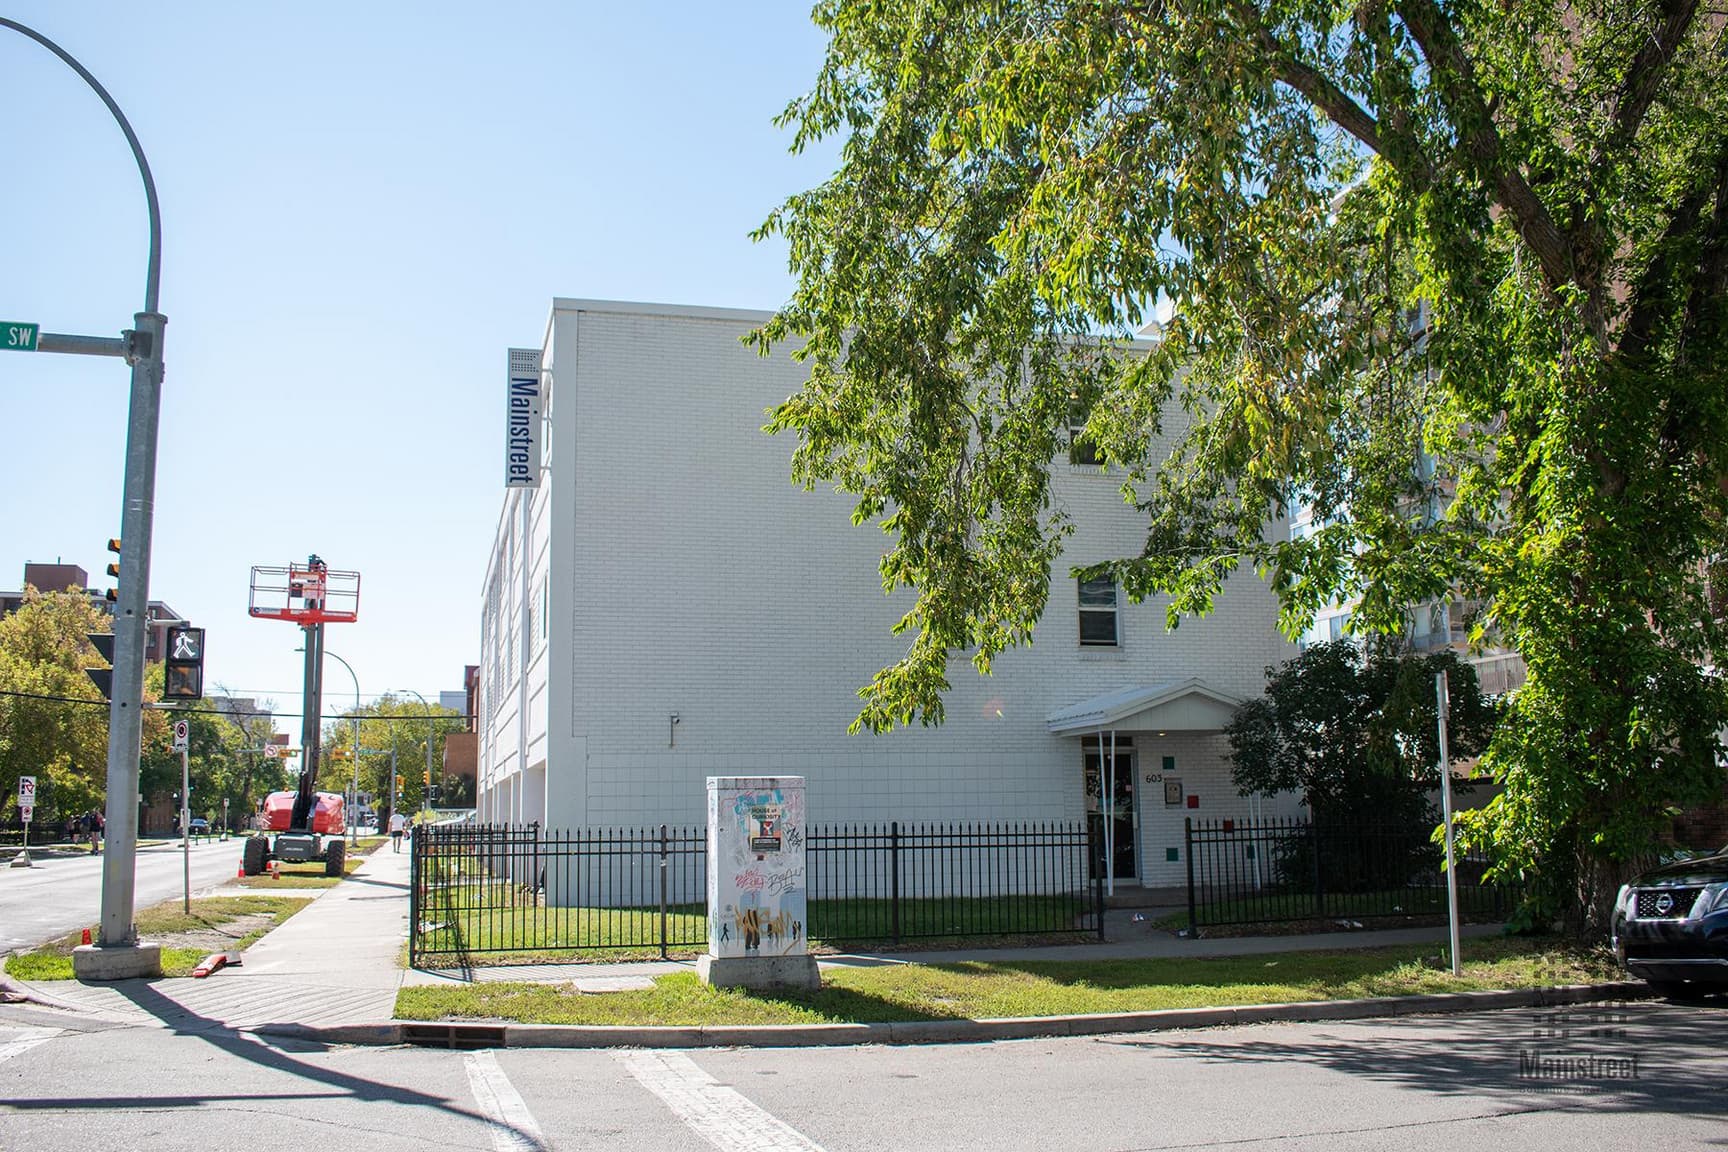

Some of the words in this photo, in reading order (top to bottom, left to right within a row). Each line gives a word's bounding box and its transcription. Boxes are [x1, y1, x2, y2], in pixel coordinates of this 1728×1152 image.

[8, 326, 32, 346] SW
[509, 378, 538, 483] Mainstreet
[1145, 774, 1162, 783] 603
